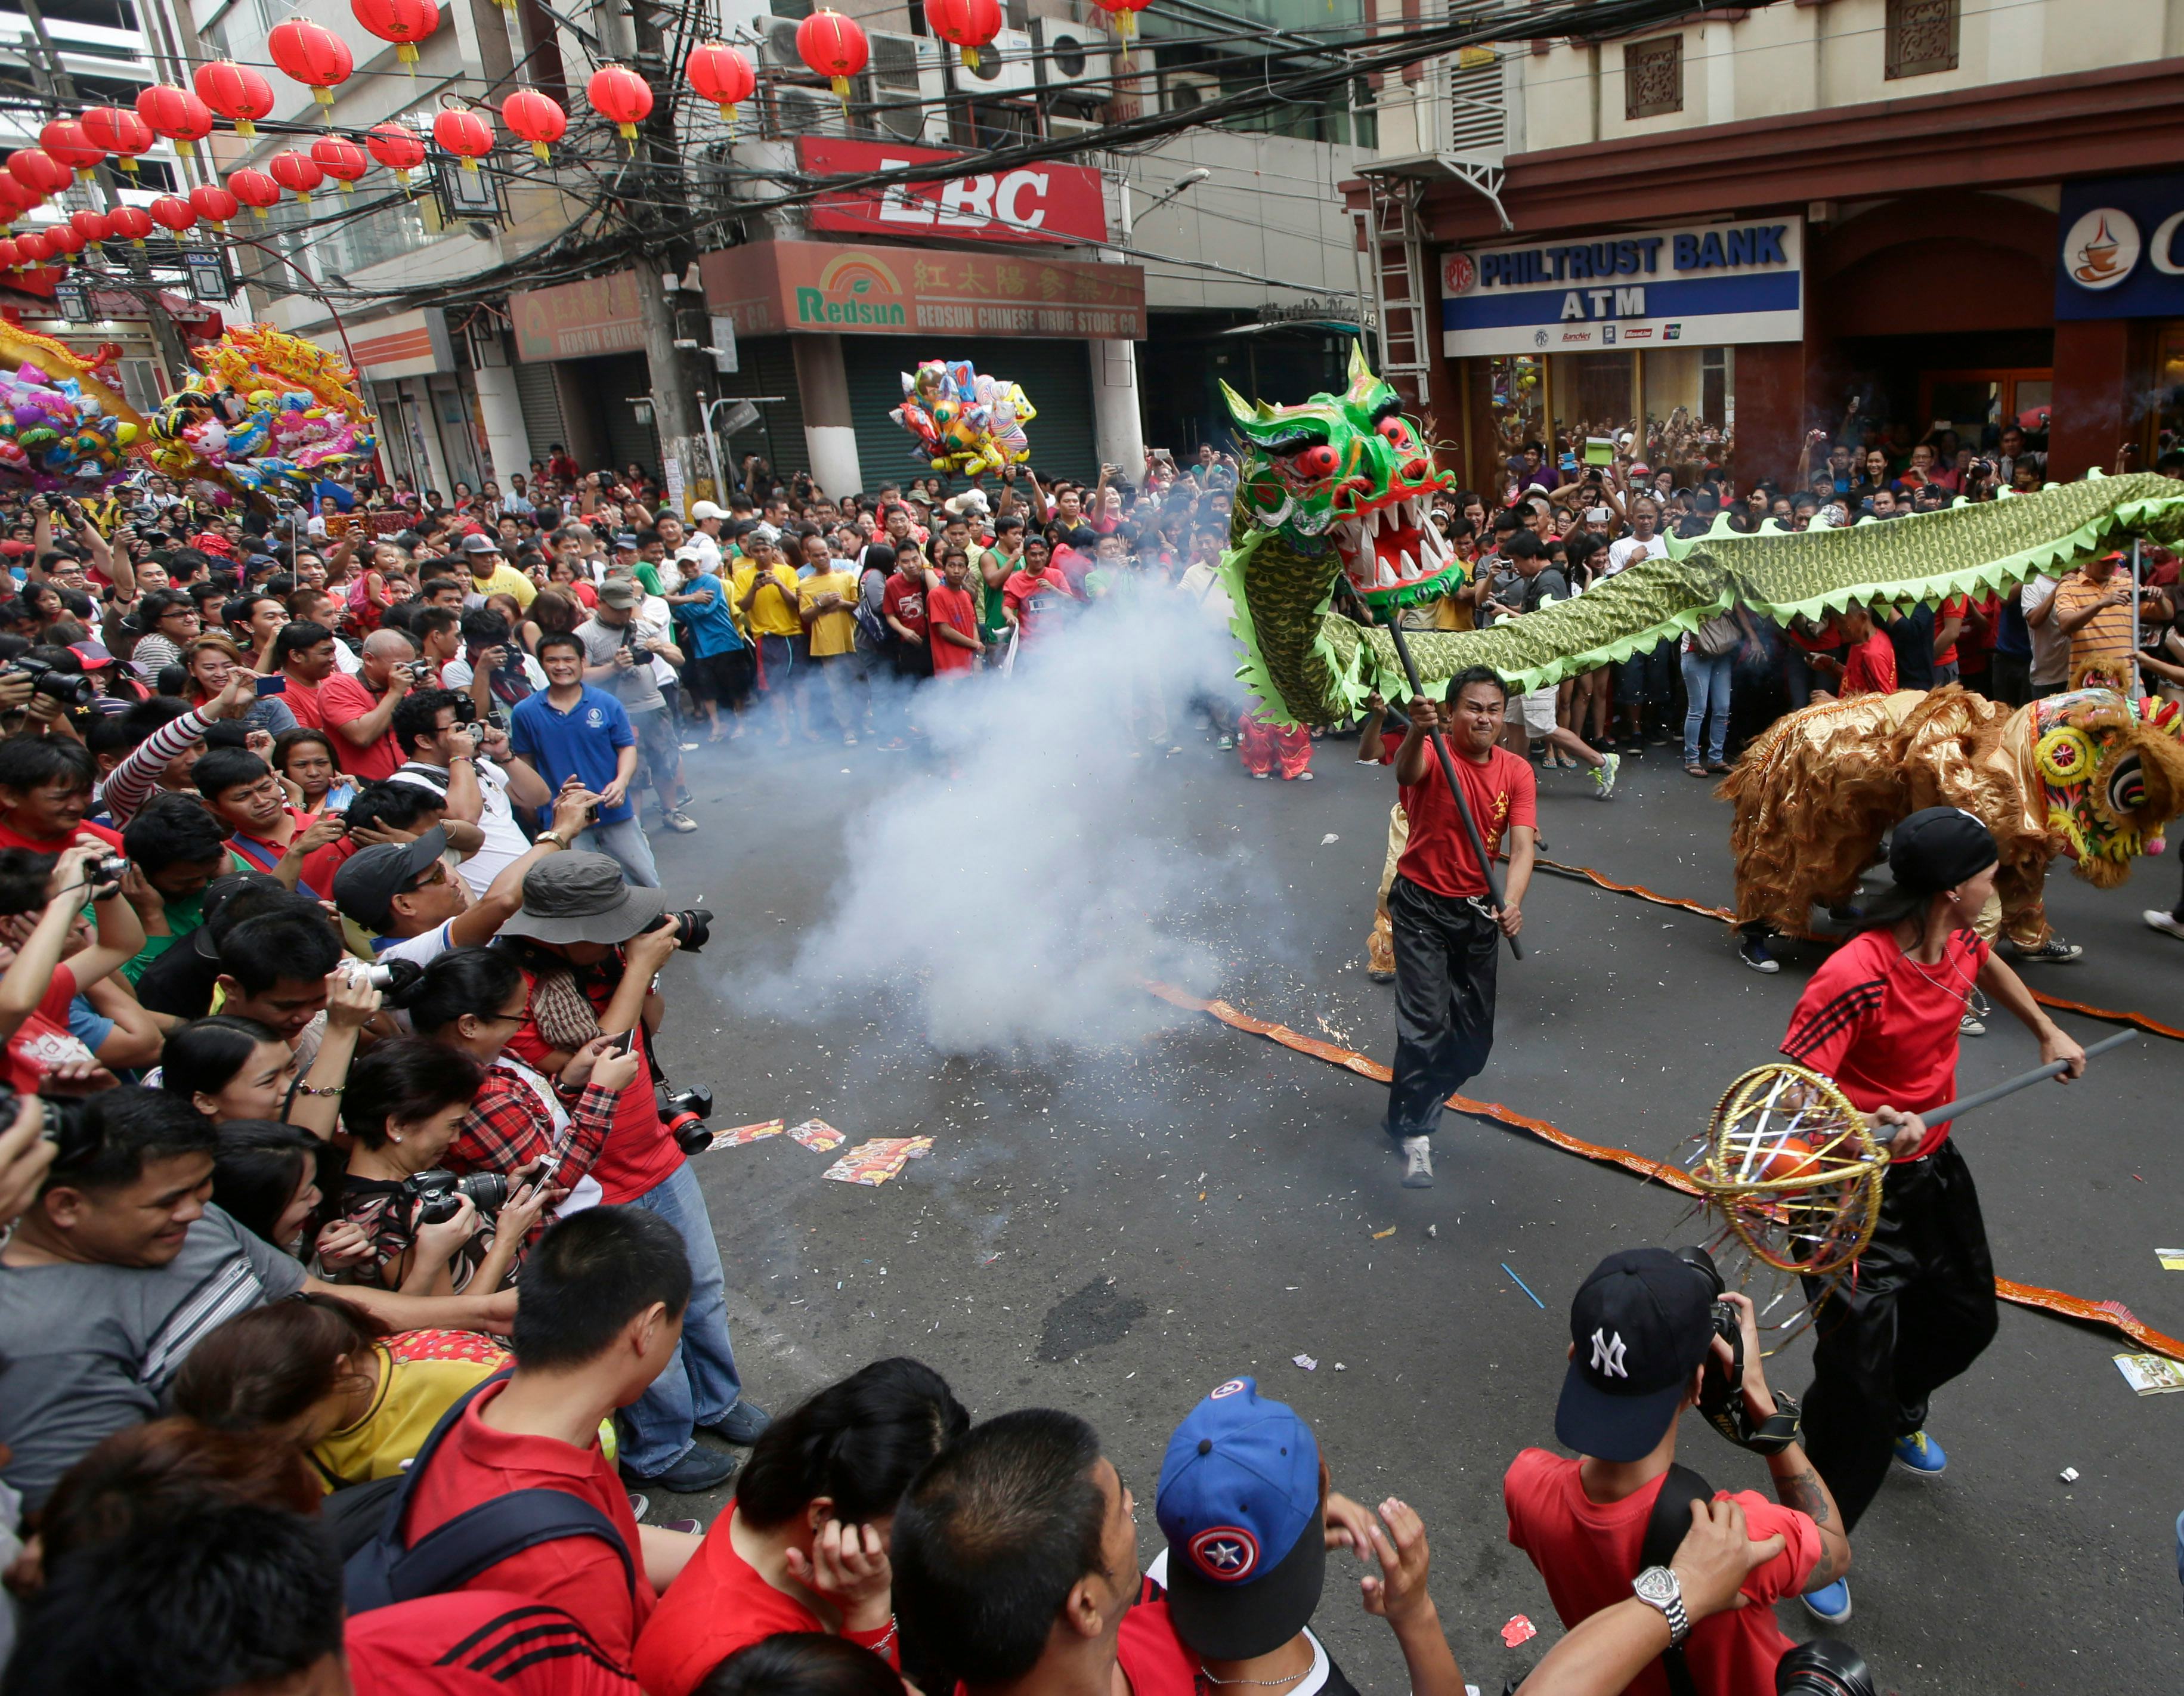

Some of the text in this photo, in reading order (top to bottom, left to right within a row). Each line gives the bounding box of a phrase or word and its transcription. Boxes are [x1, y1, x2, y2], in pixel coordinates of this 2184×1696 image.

[879, 158, 1049, 233] LBC
[188, 253, 217, 264] BDO
[1480, 225, 1787, 287] PHILTRUST BANK
[55, 286, 78, 295] BDO
[796, 286, 906, 326] Redsun
[1560, 287, 1645, 320] ATM
[916, 304, 1139, 334] REDSUN CHINESE DRUG STORE CO.
[558, 328, 601, 354] REDSUN
[602, 321, 646, 348] CHINES
[1563, 332, 1591, 341] BancNet
[75, 705, 91, 714] M
